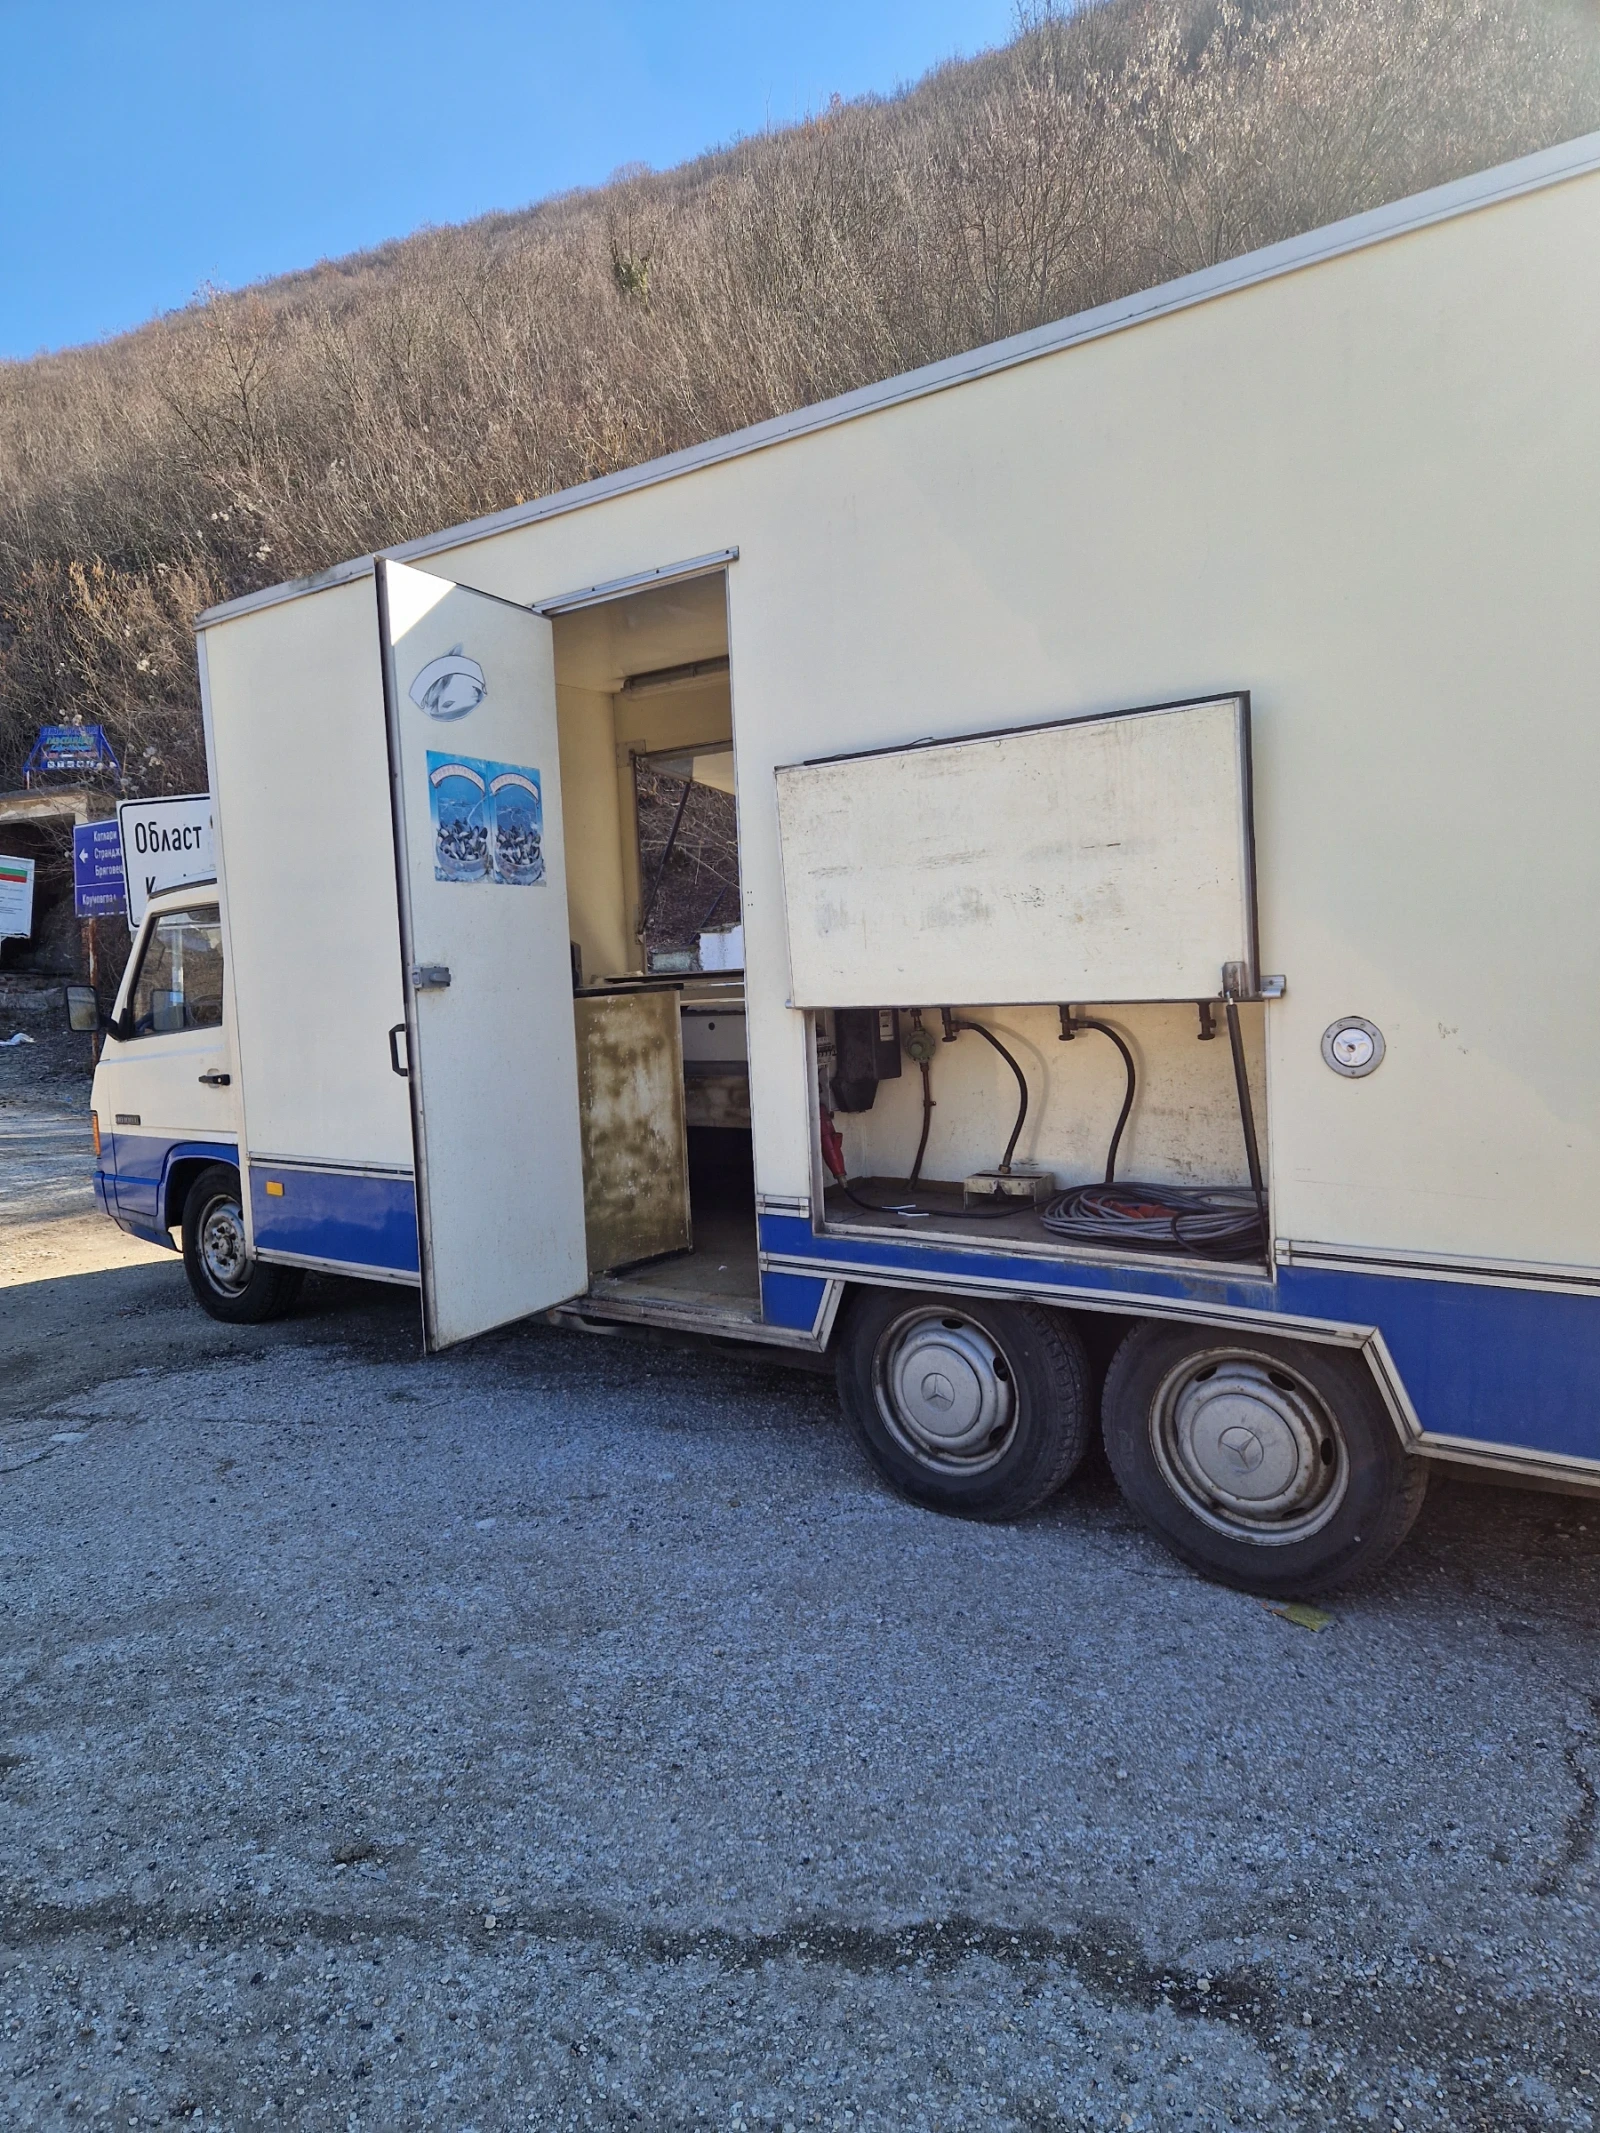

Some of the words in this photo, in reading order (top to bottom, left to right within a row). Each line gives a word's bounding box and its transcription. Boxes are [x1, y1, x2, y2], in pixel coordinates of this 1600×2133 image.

[93, 830, 118, 842] Котлари
[134, 821, 202, 854] Област
[94, 847, 122, 861] Страндж
